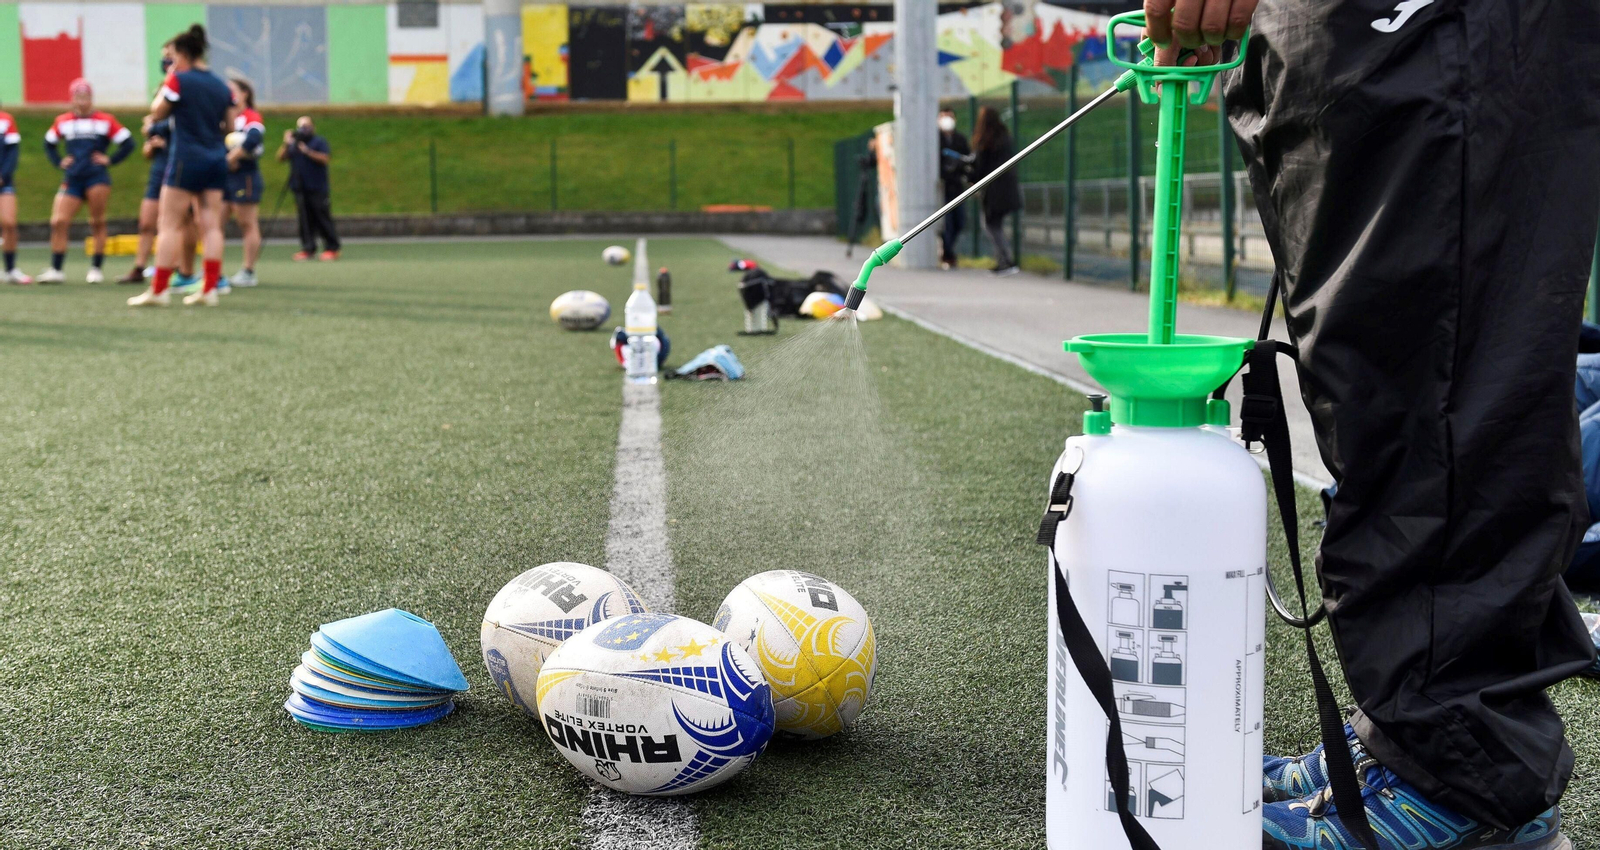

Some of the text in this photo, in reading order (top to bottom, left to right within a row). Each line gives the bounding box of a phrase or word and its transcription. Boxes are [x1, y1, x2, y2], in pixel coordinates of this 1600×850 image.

[554, 709, 648, 734] VORTEX ELITE
[1234, 659, 1242, 733] APPROXIMATELY
[544, 713, 682, 764] RHINO
